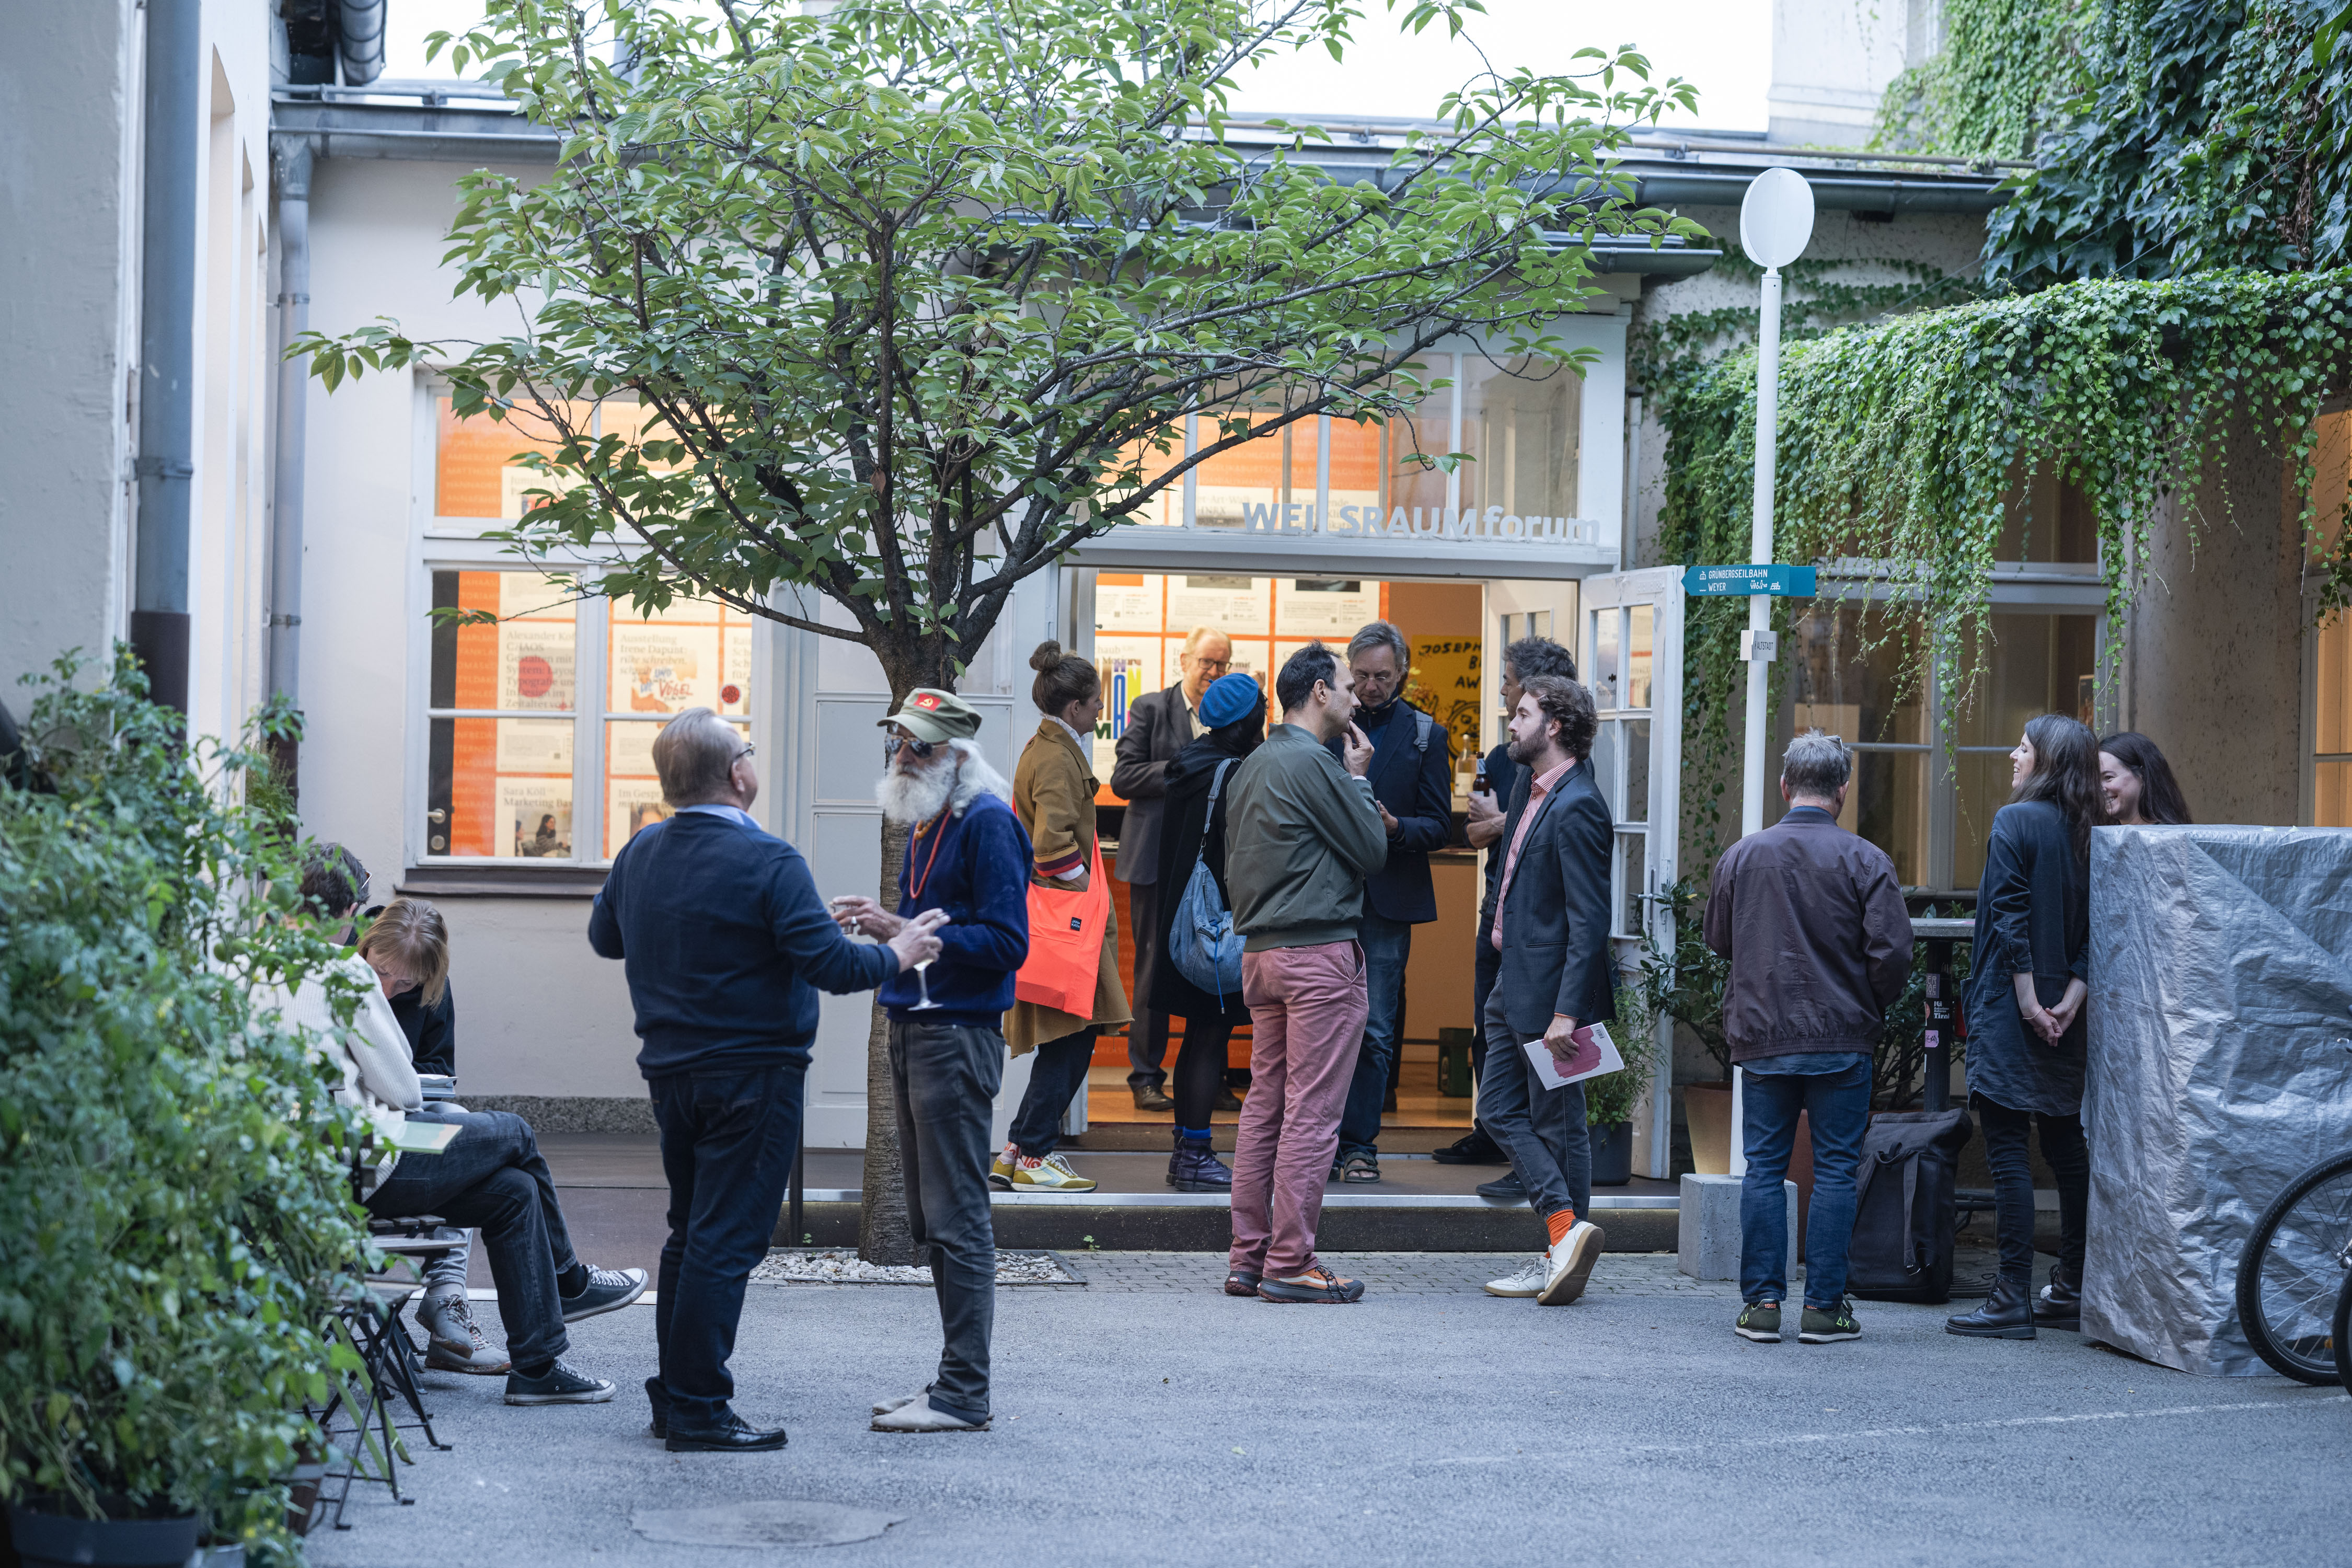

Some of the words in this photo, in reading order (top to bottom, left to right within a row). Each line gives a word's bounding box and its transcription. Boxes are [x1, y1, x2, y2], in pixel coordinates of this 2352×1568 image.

[1709, 568, 1768, 580] GRÜNBERGSEILBAHN
[1708, 582, 1726, 592] WEYER
[506, 631, 555, 641] Alexander
[620, 634, 677, 644] Ausstellung
[620, 645, 645, 653] Irene
[1757, 641, 1773, 651] ALTSTADT
[503, 787, 524, 796] Sara
[526, 786, 546, 796] Köll
[503, 797, 554, 808] Marketing
